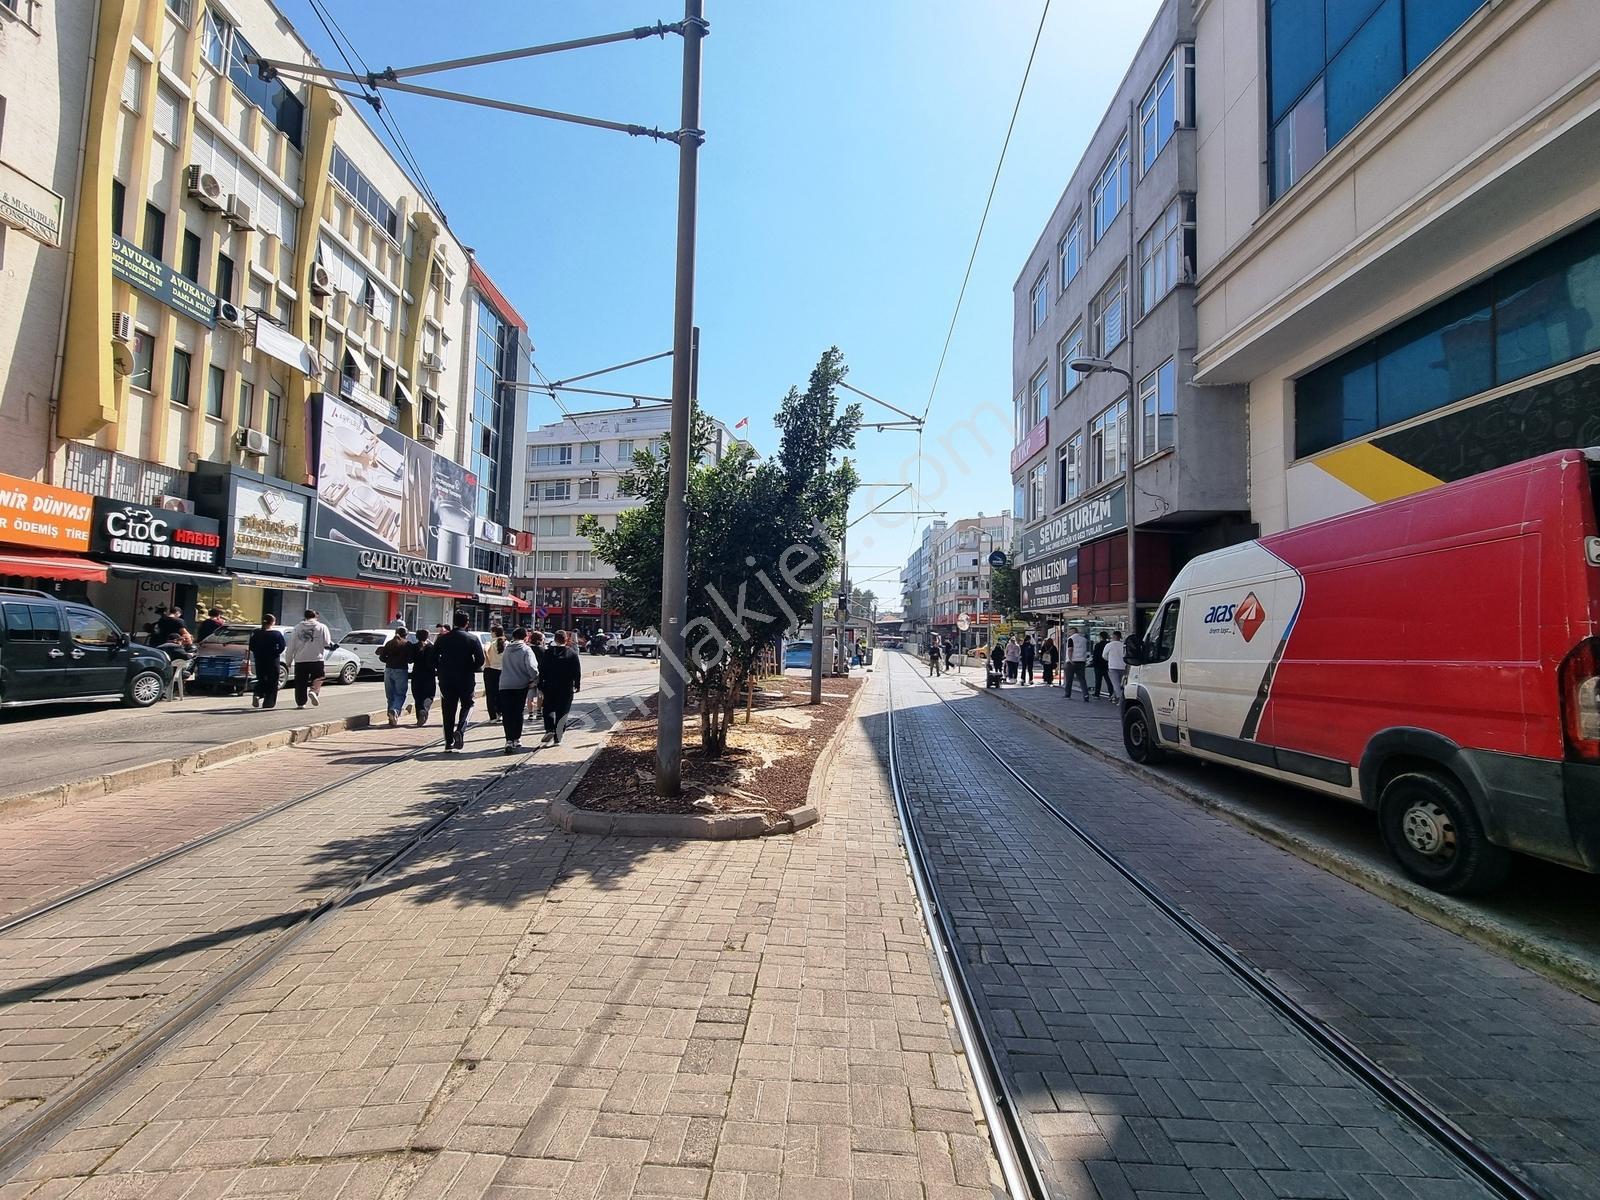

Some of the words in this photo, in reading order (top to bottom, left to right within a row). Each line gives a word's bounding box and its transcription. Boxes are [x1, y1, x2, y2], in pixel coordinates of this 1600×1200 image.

[120, 245, 162, 275] AVUKAT
[170, 274, 206, 302] AVUKAT
[172, 287, 195, 305] DAMLA
[196, 302, 211, 315] KUZU
[32, 495, 92, 522] DÜNYASI
[14, 516, 59, 539] ÖDEMİŞ
[65, 527, 89, 541] TİRE
[106, 512, 168, 542] CtoC
[1040, 515, 1068, 546] SEVDE
[110, 538, 151, 556] COME
[153, 543, 171, 558] TO
[171, 546, 213, 563] COFFEE
[359, 550, 412, 573] GALLERY
[411, 560, 452, 580] CRYSTAL
[141, 581, 170, 592] CtoC
[1204, 603, 1236, 624] aras
